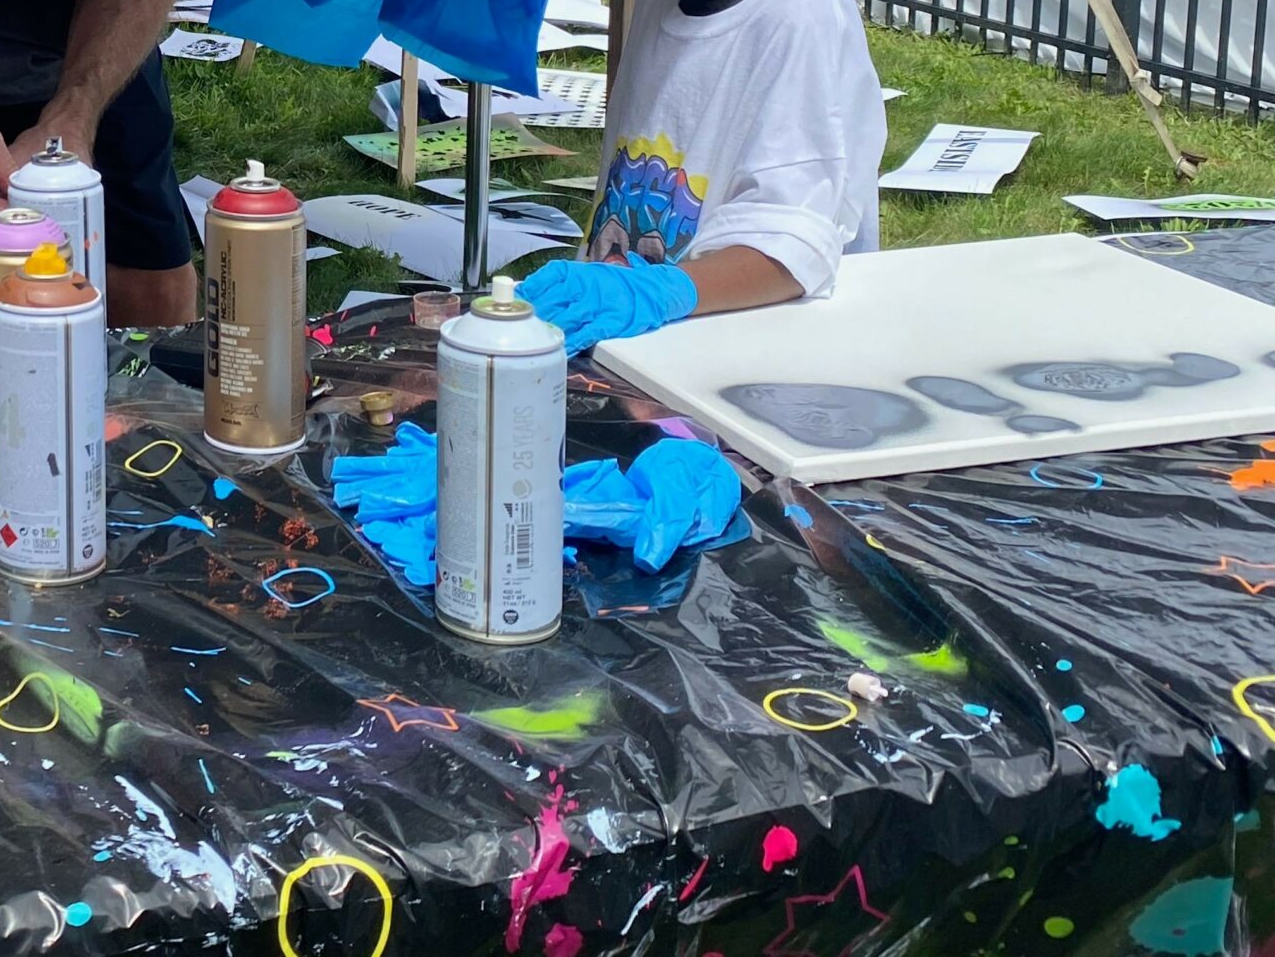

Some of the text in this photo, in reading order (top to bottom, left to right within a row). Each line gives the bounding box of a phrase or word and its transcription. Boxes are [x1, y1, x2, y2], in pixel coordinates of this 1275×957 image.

[220, 251, 228, 319] NC-ACRYLIC
[207, 278, 220, 377] GOLD
[512, 405, 534, 471] 25 YEARS
